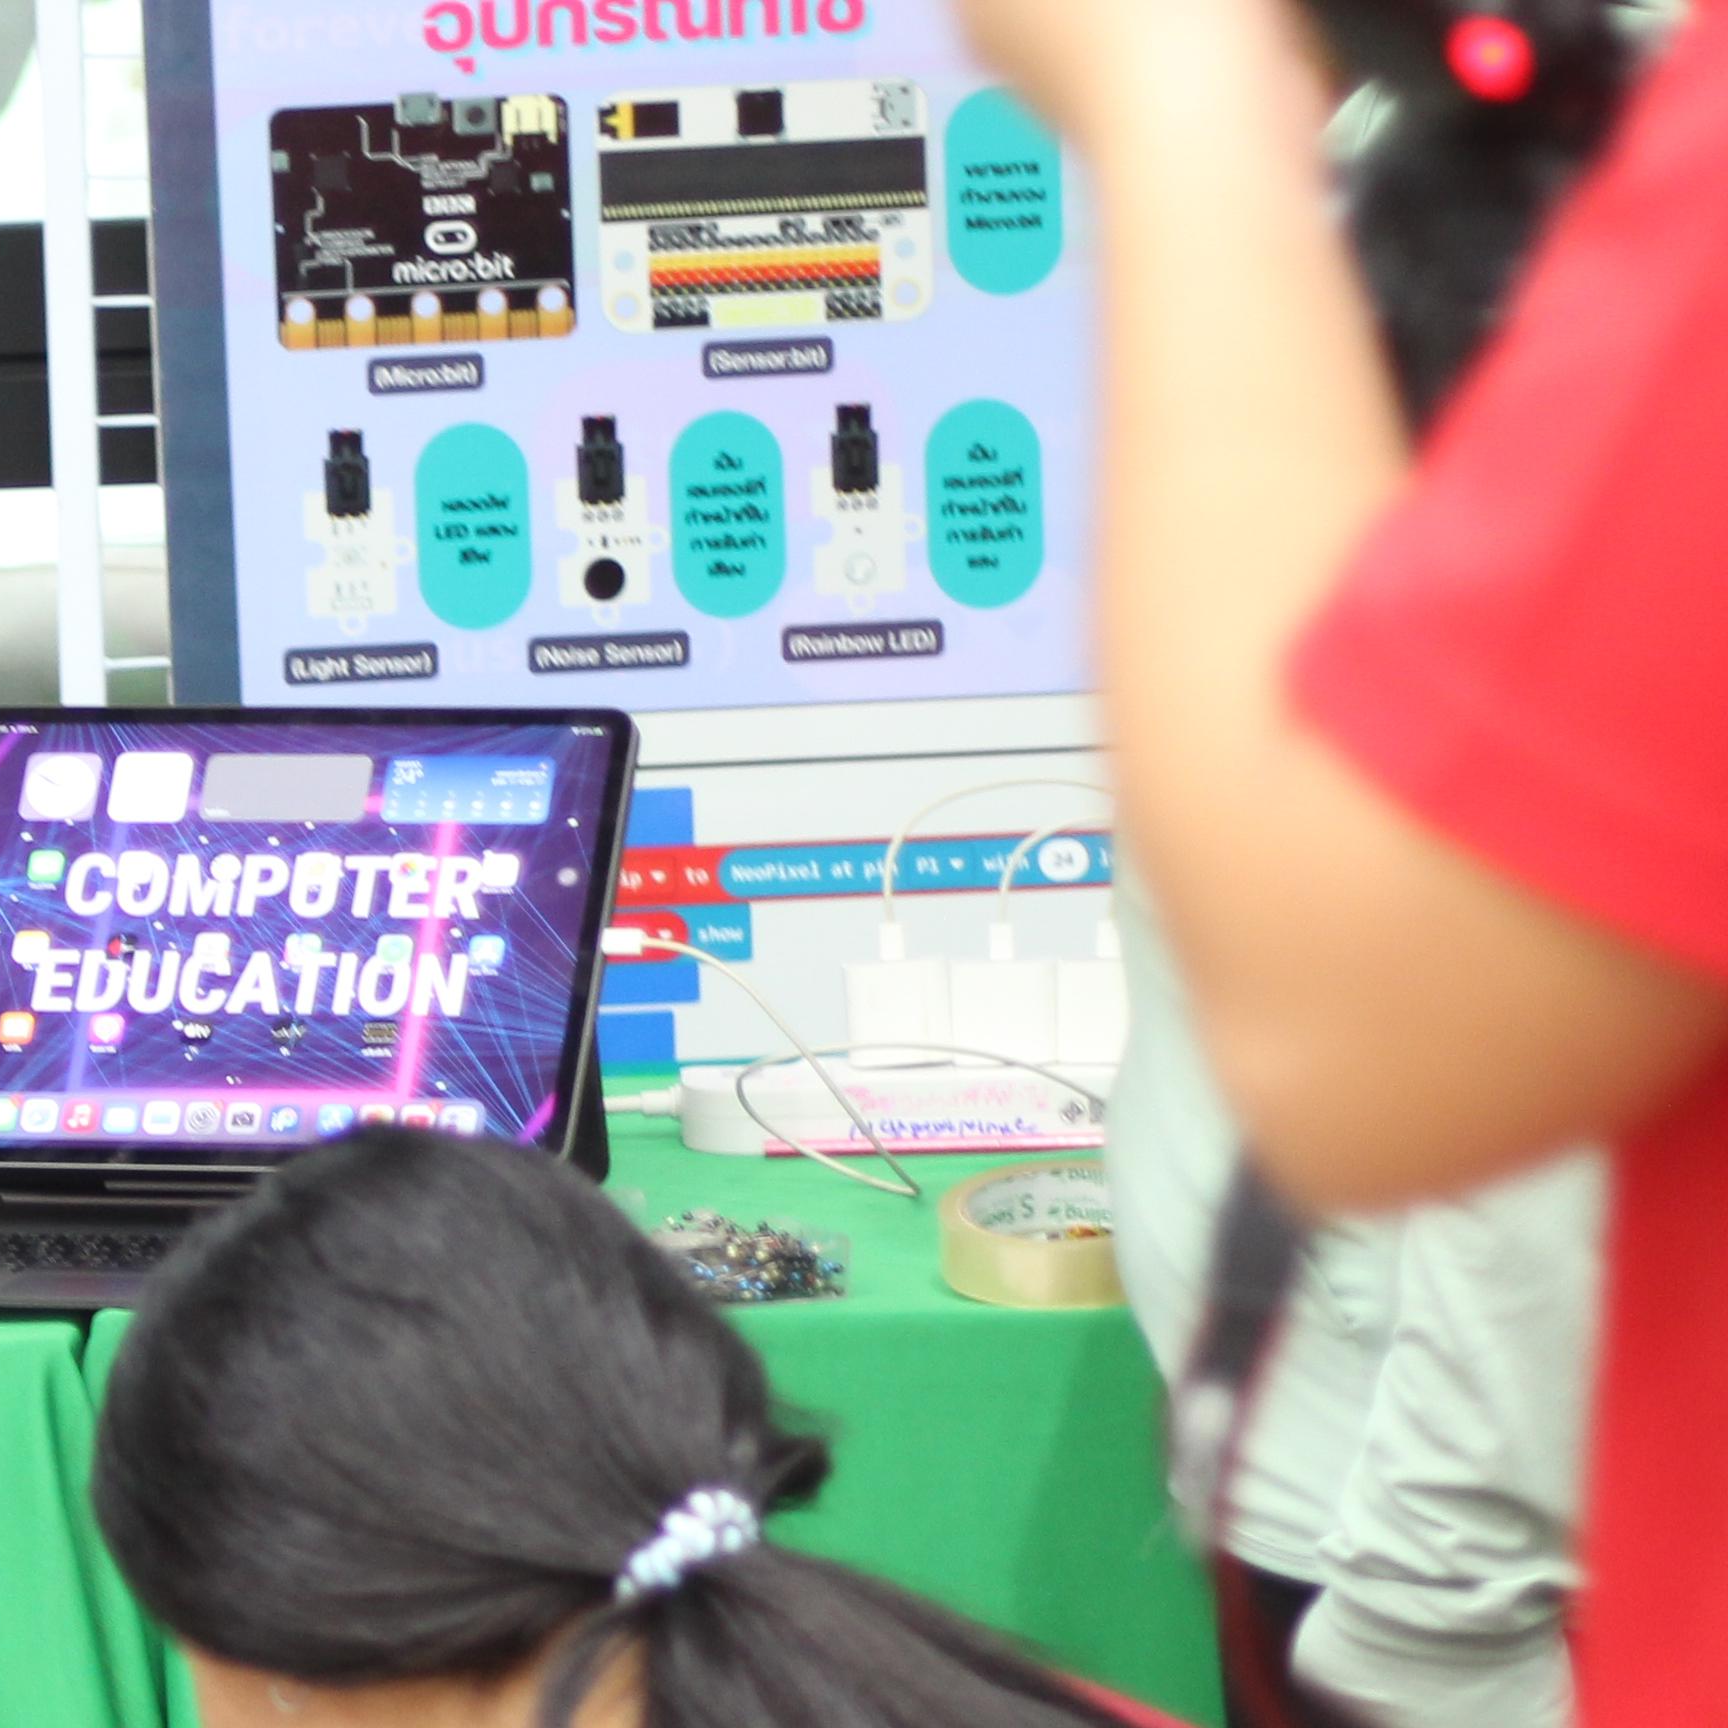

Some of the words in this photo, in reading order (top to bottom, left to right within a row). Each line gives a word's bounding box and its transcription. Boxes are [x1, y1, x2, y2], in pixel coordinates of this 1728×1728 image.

[392, 251, 515, 284] micro:bit
[709, 344, 828, 375] (Sensor:bit)
[374, 361, 479, 390] (Micro:bit)
[433, 523, 470, 540] LED
[535, 644, 600, 670] (Noise
[604, 639, 684, 666] Sensor)
[789, 632, 885, 658] (Rainbow
[888, 627, 937, 652] LED)
[290, 653, 350, 684] (Light
[353, 650, 434, 678] Sensor)
[65, 850, 482, 919] COMPUTER
[685, 866, 709, 887] to
[730, 859, 822, 884] NeoPixel
[830, 860, 854, 880] at
[697, 924, 744, 944] show
[29, 948, 469, 1018] EDUCATION
